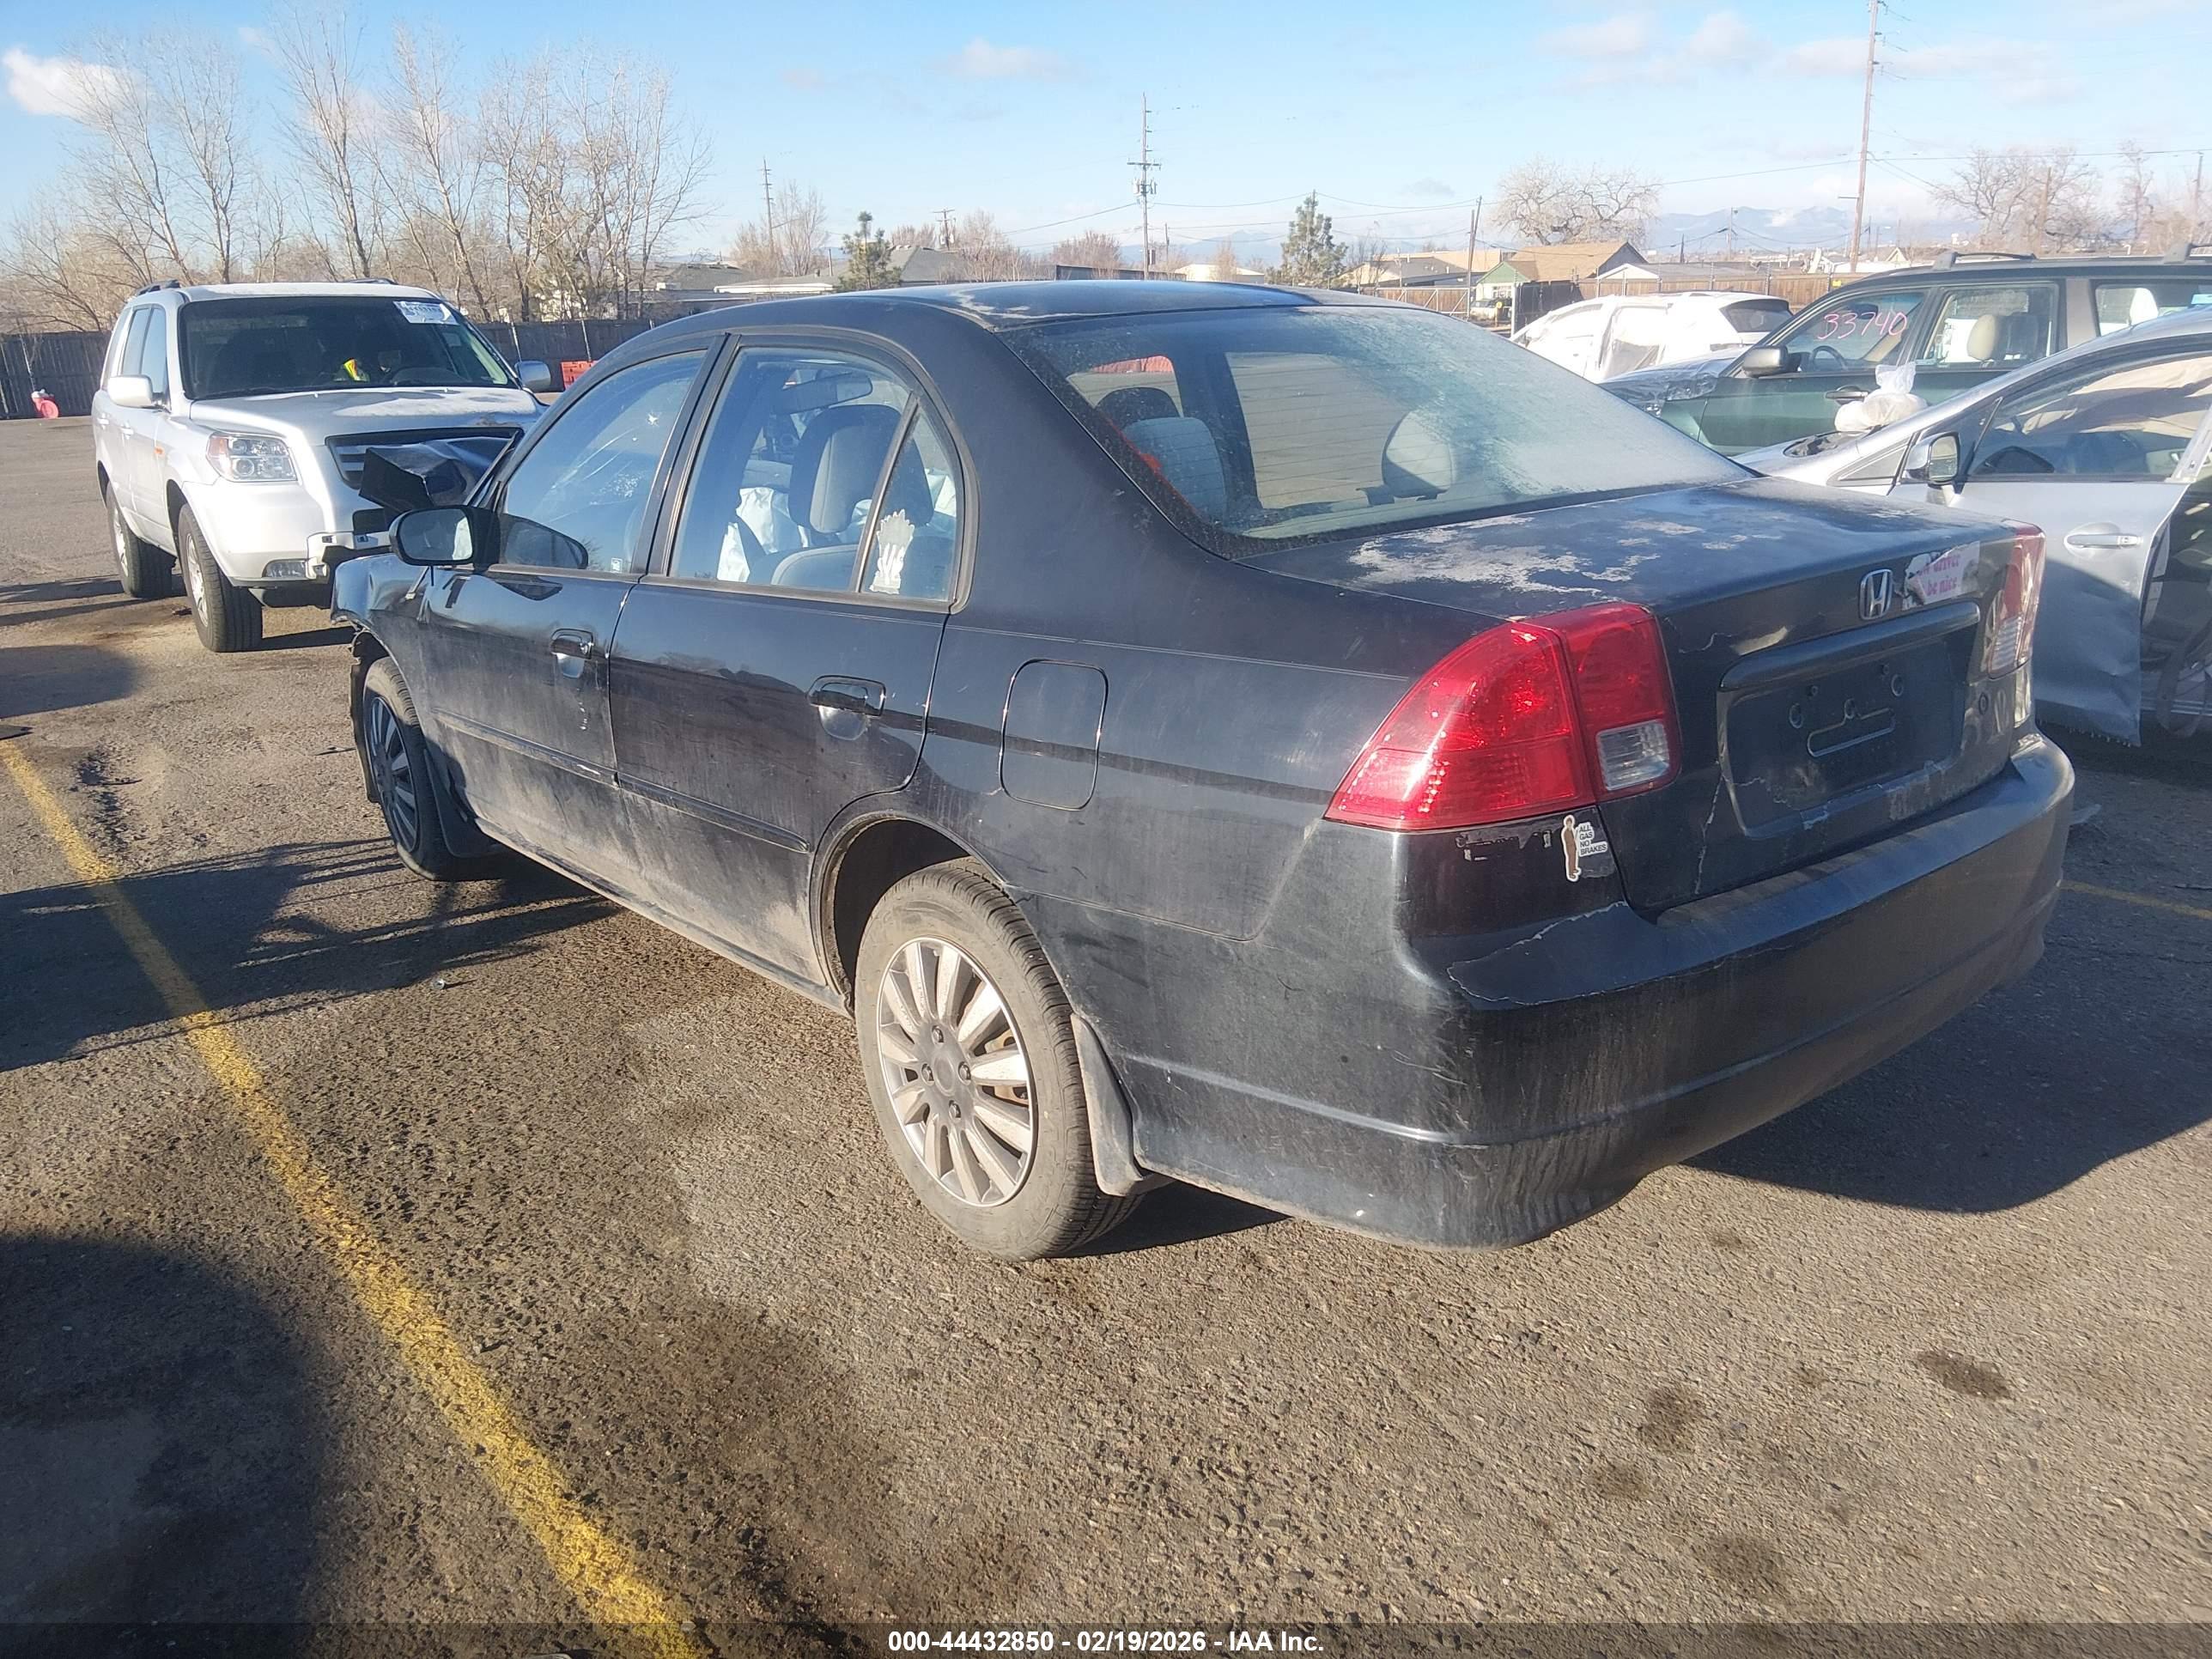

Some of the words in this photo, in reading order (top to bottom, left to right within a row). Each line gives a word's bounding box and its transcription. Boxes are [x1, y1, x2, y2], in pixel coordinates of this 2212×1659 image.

[1817, 312, 1908, 340] 33740
[1926, 579, 1938, 596] be
[1939, 574, 1958, 592] nice
[1579, 824, 1592, 833] ALL
[1580, 832, 1593, 841] GAS
[1580, 840, 1590, 848] NO
[1580, 844, 1607, 855] BRAKES
